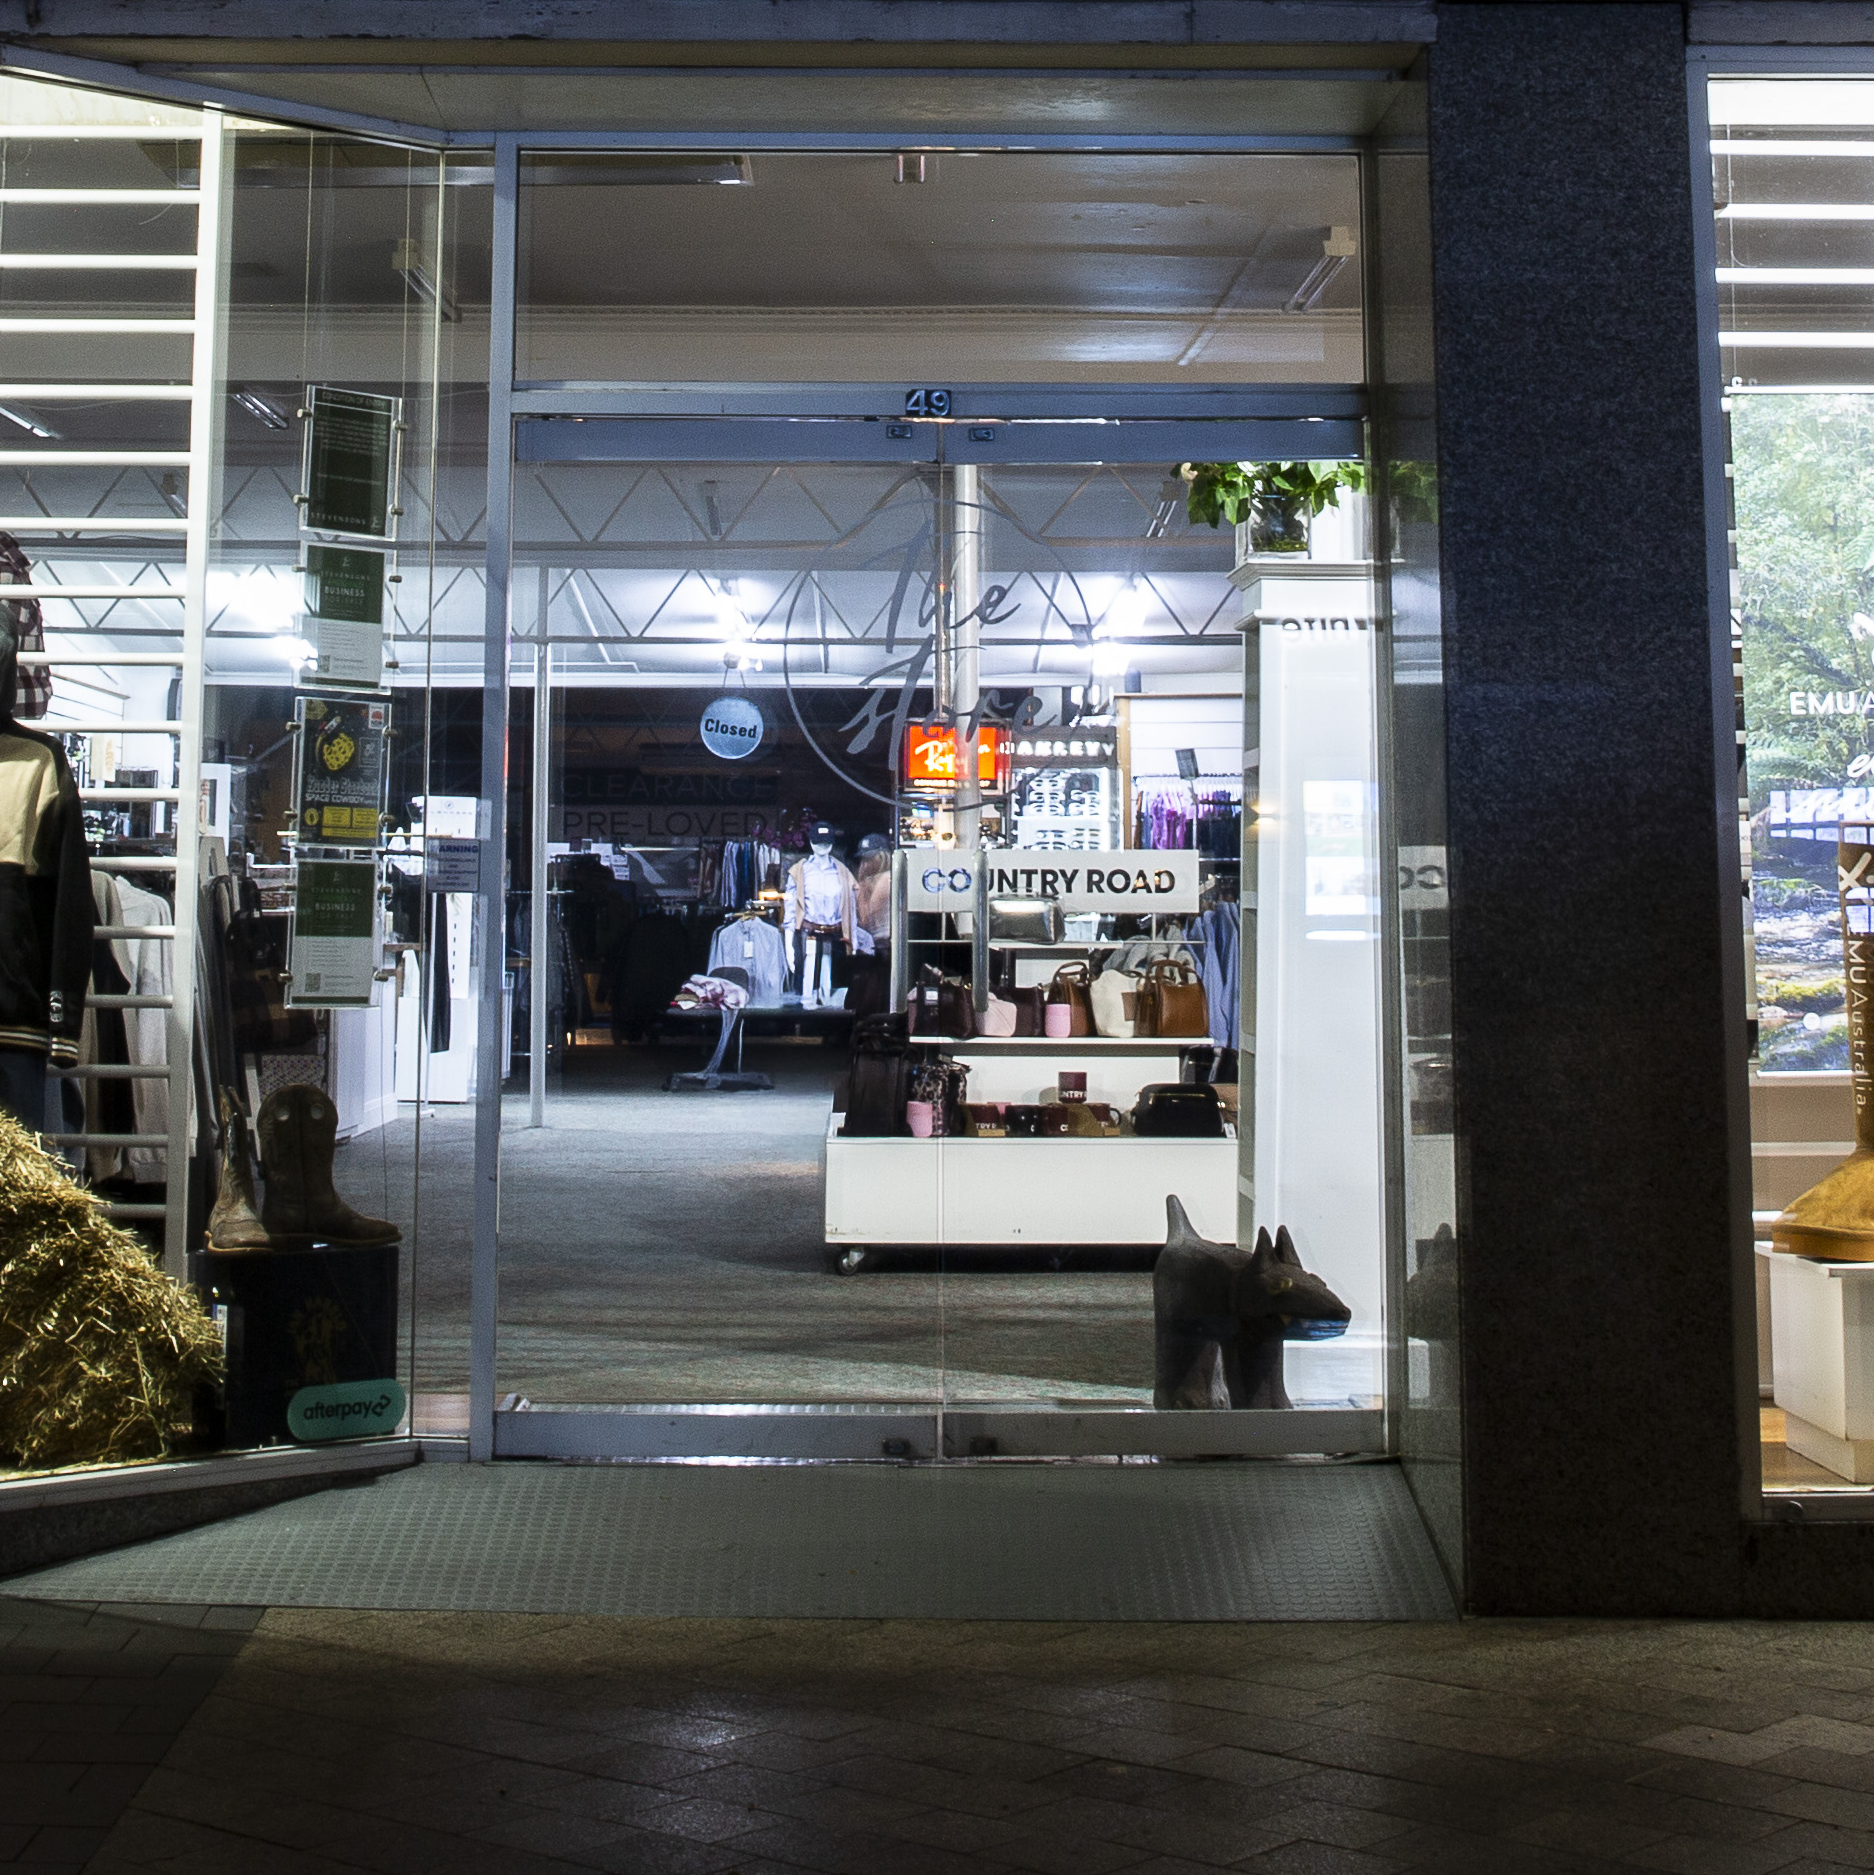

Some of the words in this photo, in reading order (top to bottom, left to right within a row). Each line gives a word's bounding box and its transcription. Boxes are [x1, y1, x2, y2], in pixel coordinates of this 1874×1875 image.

[906, 389, 950, 416] 49
[324, 585, 365, 597] BUSINESS
[859, 518, 1022, 654] The
[1789, 691, 1856, 716] EMU
[704, 717, 758, 740] Closed
[564, 773, 772, 798] CLEARANCE
[305, 793, 331, 803] SPACE
[331, 794, 365, 805] COWBOY
[563, 810, 767, 837] PRE-LOVED
[431, 844, 479, 854] ARNING
[1086, 868, 1176, 895] ROAD
[314, 902, 356, 912] BUSINESS
[303, 1399, 373, 1423] afterpay
